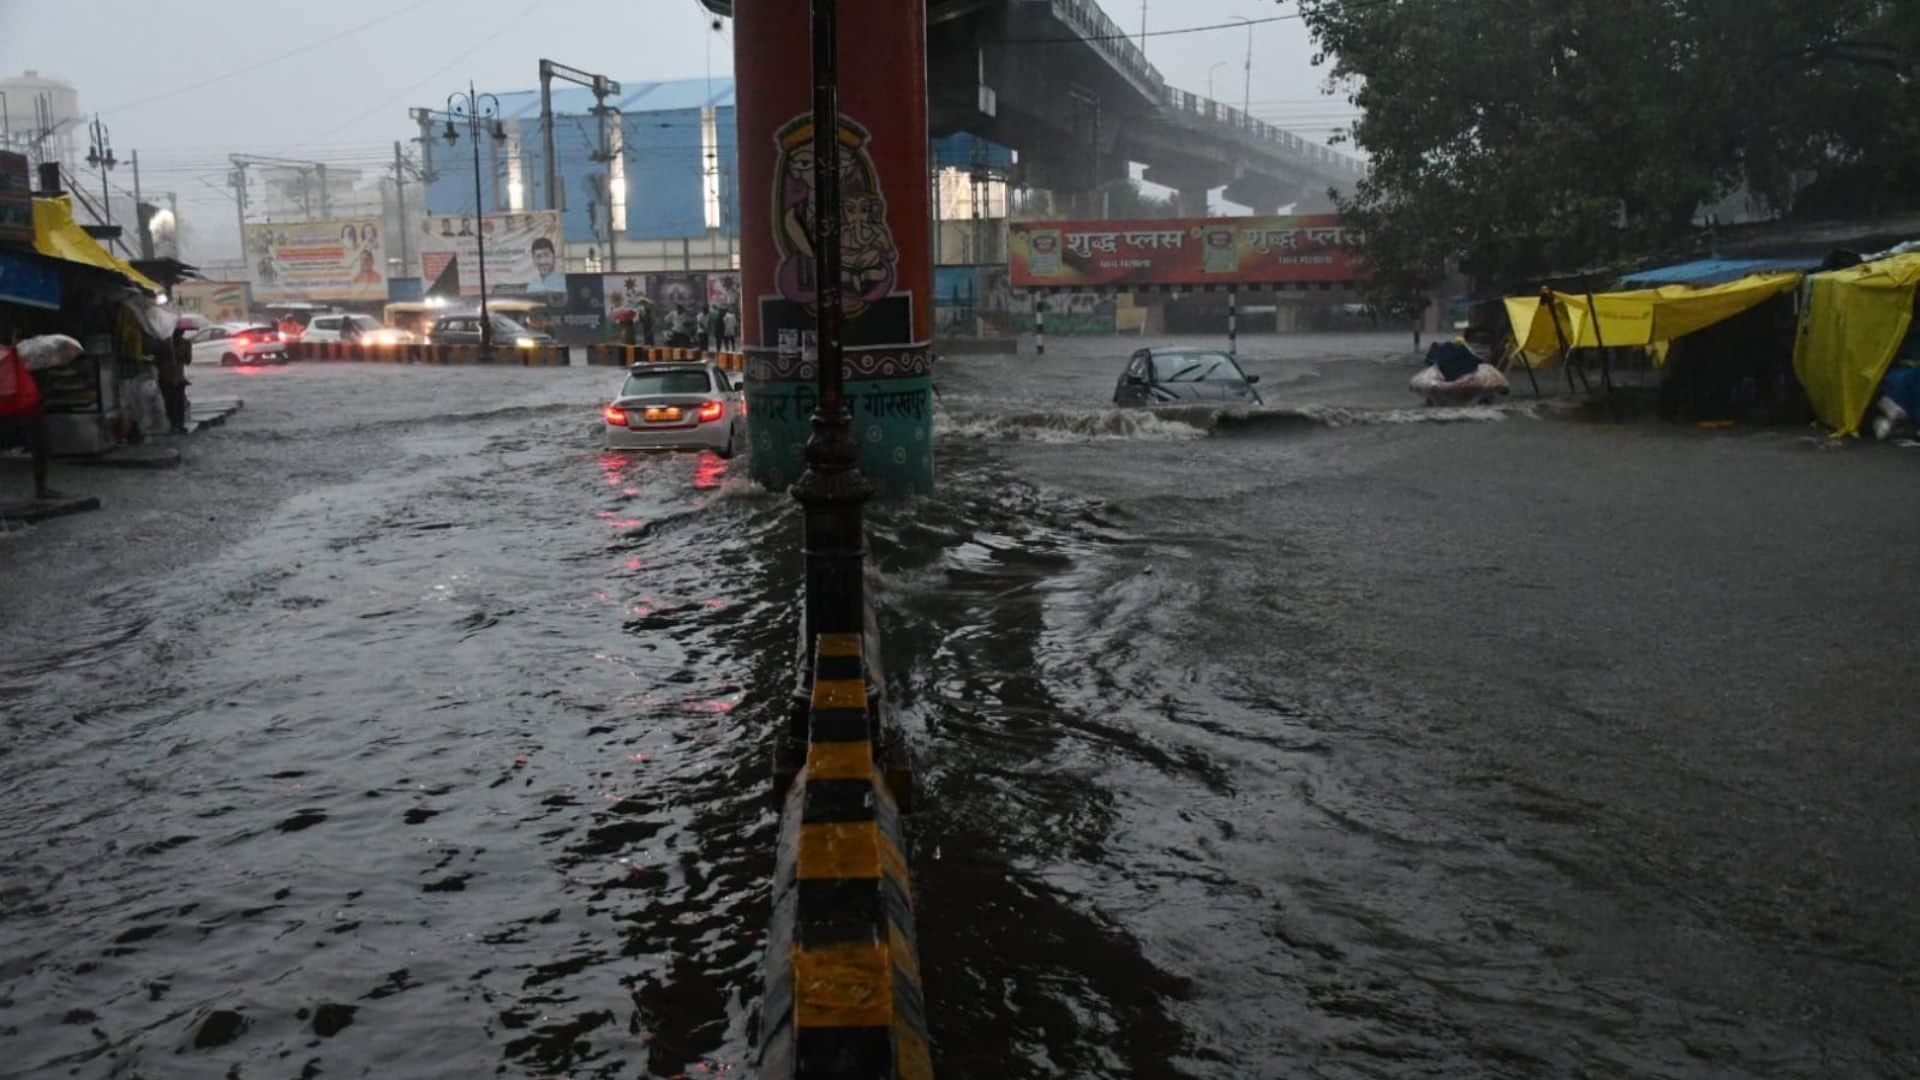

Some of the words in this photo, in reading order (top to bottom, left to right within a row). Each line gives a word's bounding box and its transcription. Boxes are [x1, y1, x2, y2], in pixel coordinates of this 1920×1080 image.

[1064, 232, 1119, 258] शुद्ध
[1122, 230, 1185, 249] प्लस
[1242, 227, 1299, 255] शुद्ध
